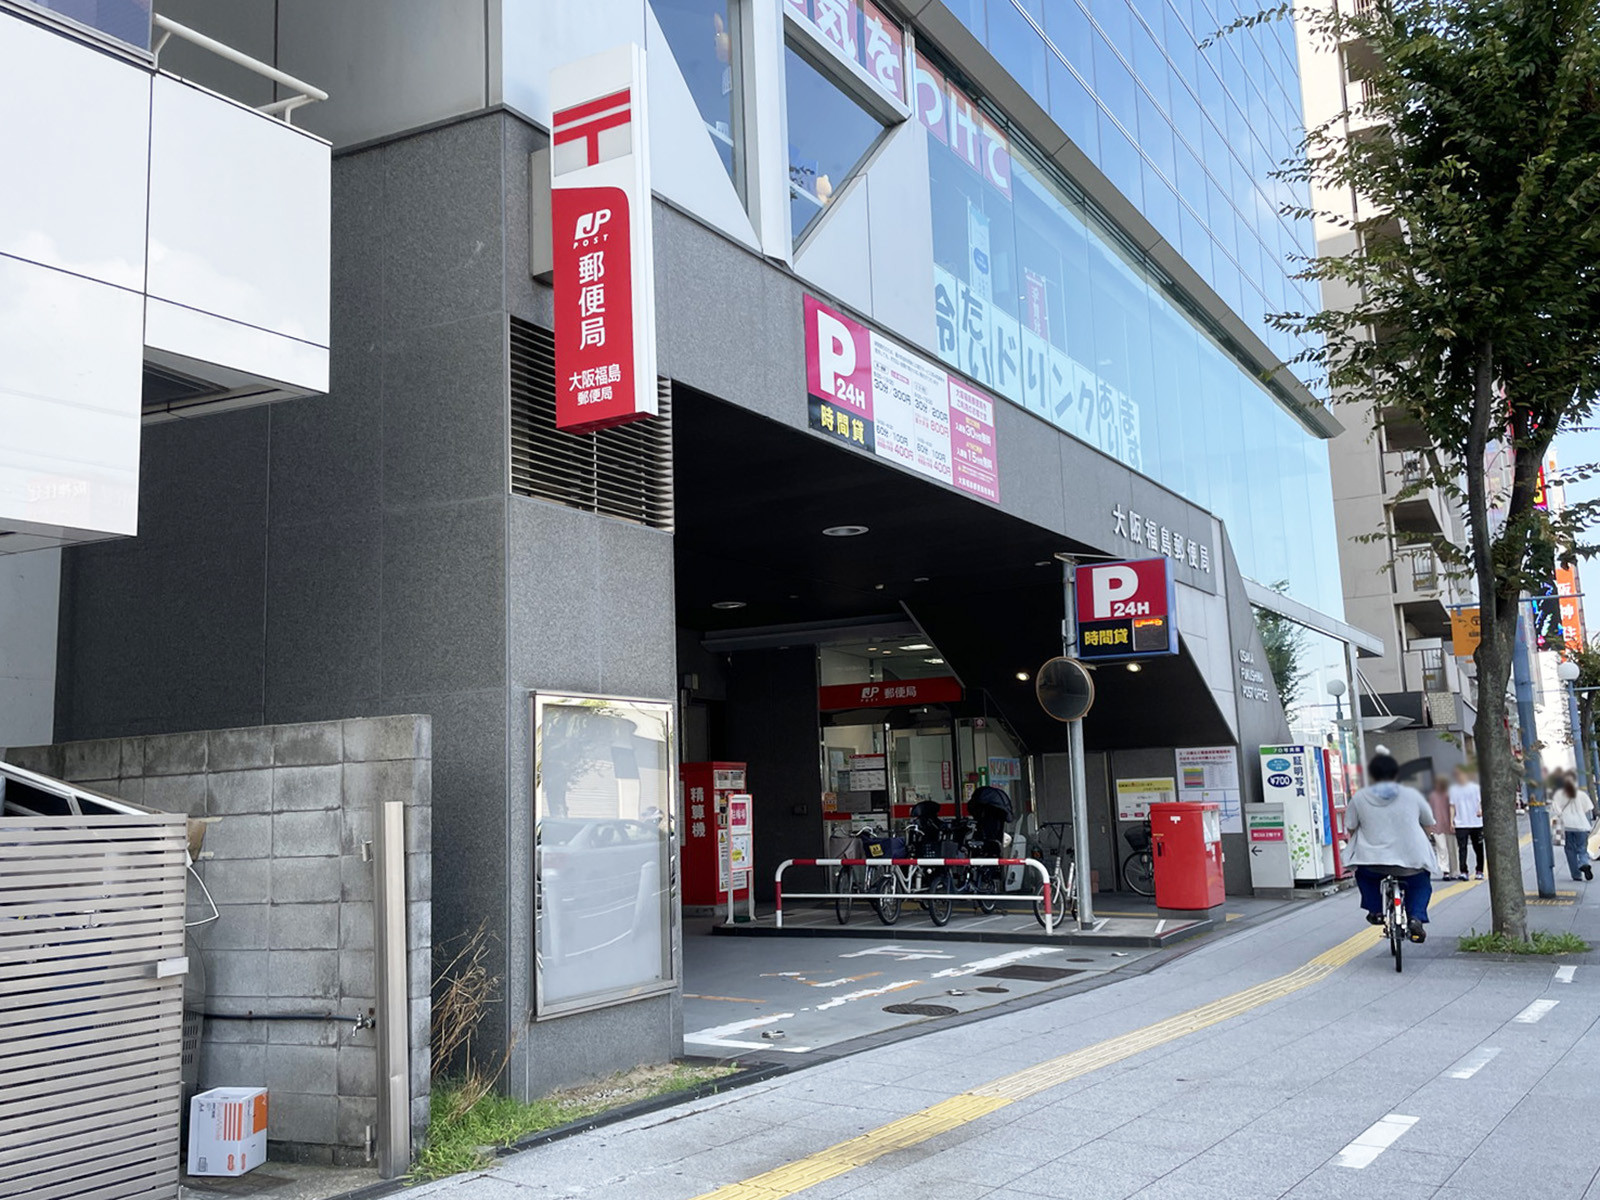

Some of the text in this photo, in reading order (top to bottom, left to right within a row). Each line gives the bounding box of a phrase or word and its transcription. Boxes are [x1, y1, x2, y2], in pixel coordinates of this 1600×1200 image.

[787, 0, 1009, 190] 気をつけて
[573, 234, 609, 249] POST
[578, 251, 606, 350] 郵便局
[817, 309, 856, 396] P
[568, 363, 621, 391] 大阪福島
[577, 385, 612, 405] 郵便局
[836, 378, 866, 410] 24H
[820, 404, 865, 445] 時間貸
[1112, 503, 1210, 574] 大阪福島郵便局
[1092, 565, 1138, 619] P
[1113, 601, 1150, 617] 24H
[1084, 628, 1129, 646] 時間貸
[884, 686, 917, 698] 郵便局
[1270, 776, 1290, 785] ¥700
[1293, 756, 1306, 797] 証明写真
[690, 787, 706, 837] 精算機
